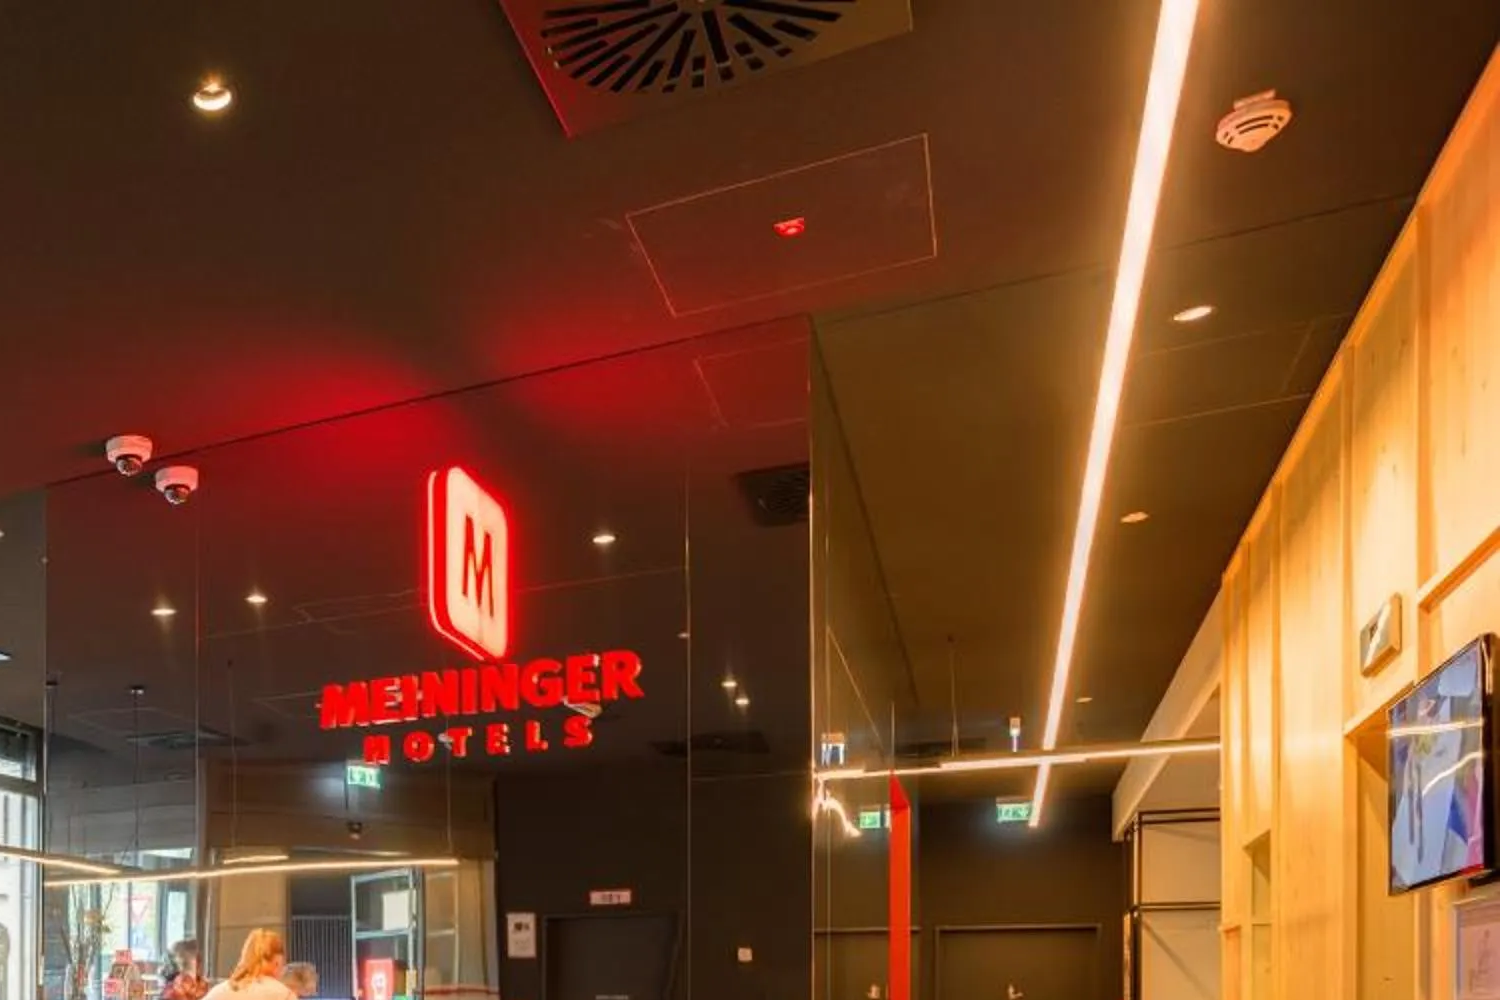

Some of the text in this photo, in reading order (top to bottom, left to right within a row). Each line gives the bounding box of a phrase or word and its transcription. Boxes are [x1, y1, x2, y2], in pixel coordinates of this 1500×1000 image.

[462, 514, 494, 618] M
[320, 650, 644, 729] MEININGER
[363, 715, 593, 765] HOTELS
